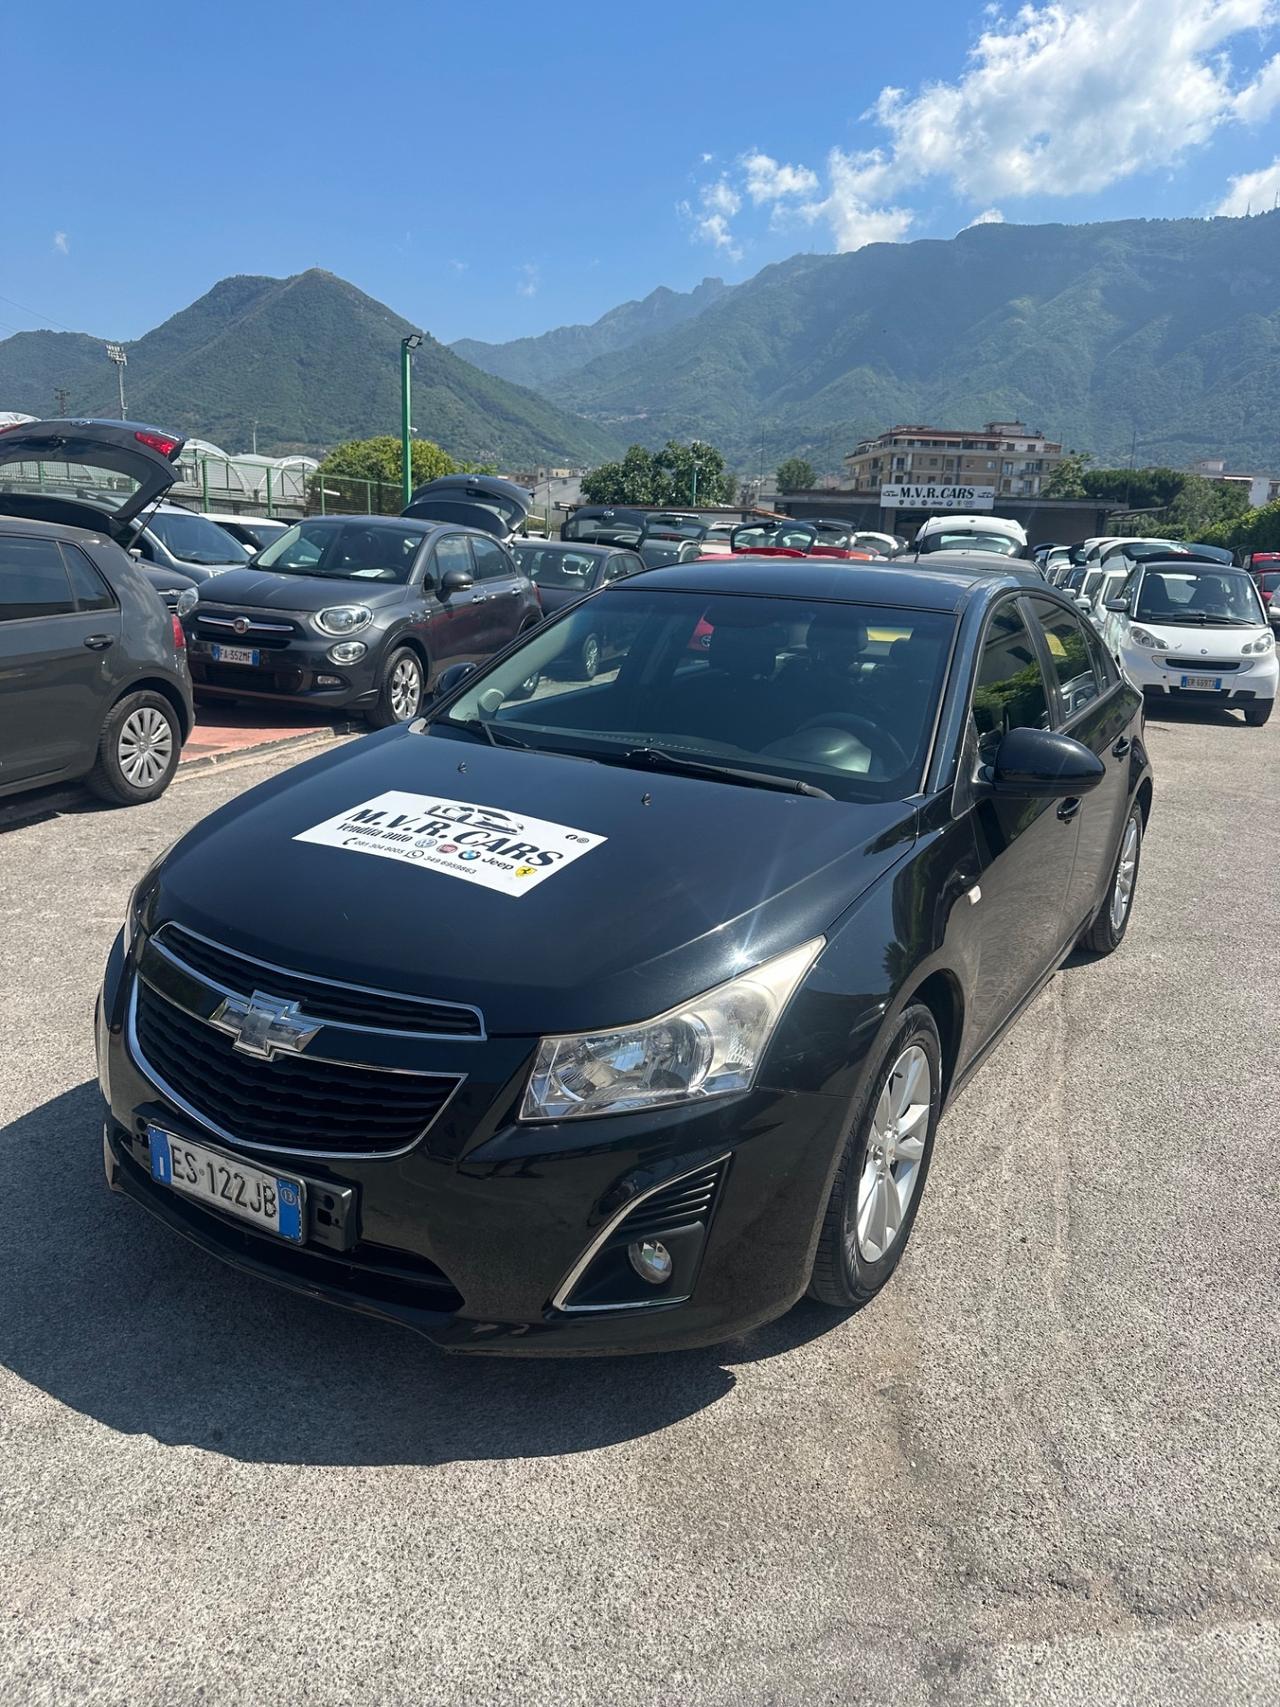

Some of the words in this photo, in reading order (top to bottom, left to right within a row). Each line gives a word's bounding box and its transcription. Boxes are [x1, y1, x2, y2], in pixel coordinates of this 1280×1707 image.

[336, 822, 384, 837] Vendita
[381, 832, 413, 842] auto
[482, 857, 514, 870] Jeep
